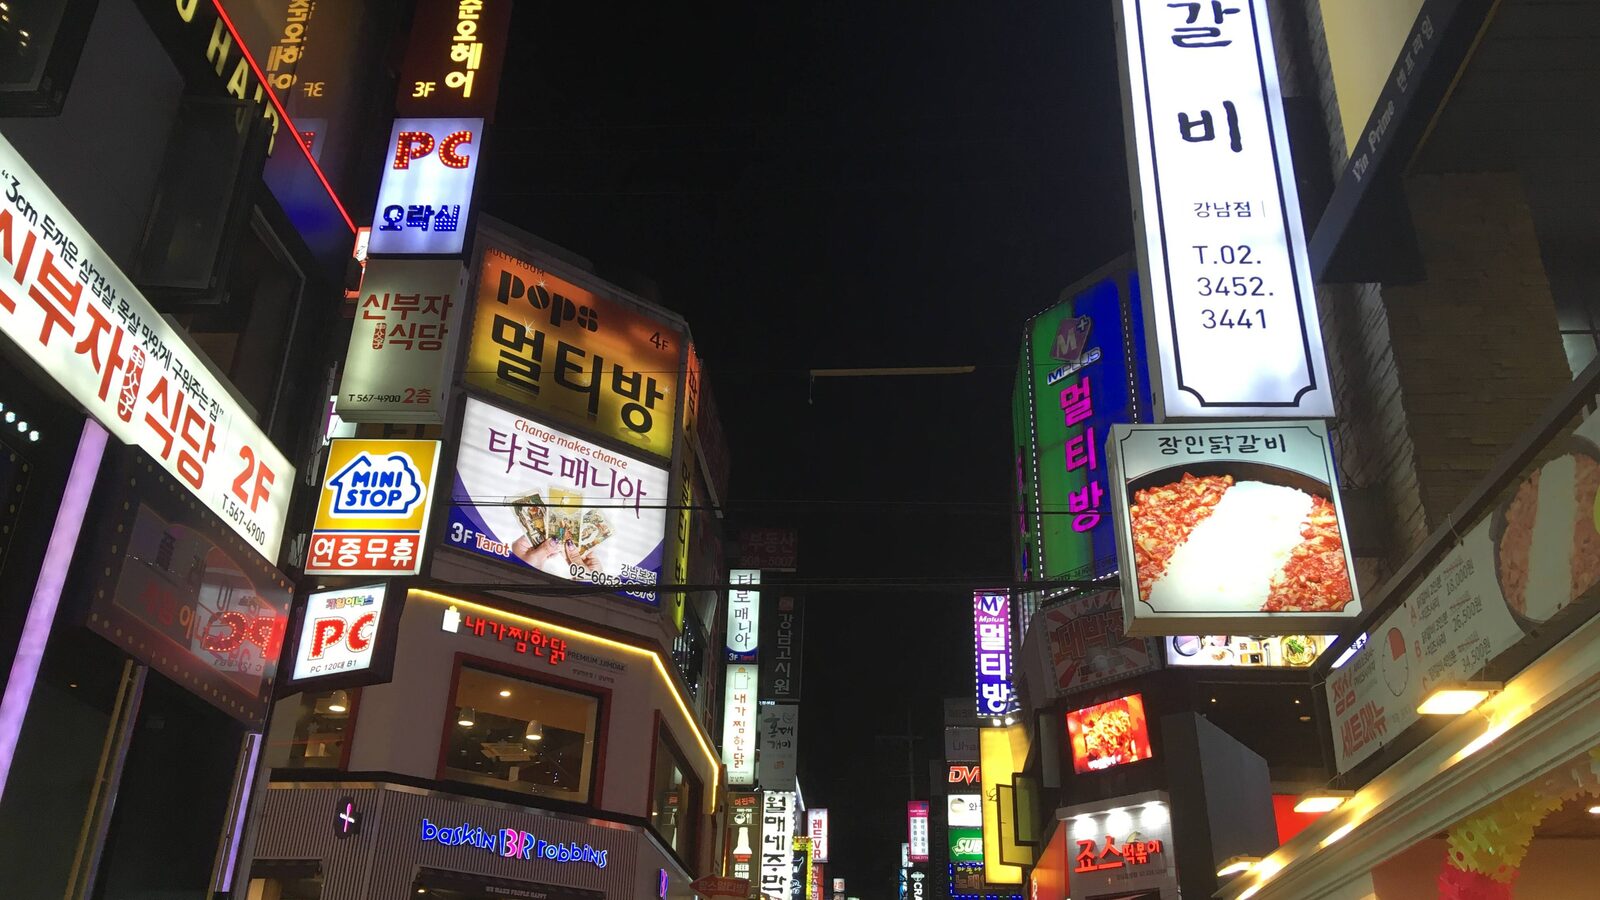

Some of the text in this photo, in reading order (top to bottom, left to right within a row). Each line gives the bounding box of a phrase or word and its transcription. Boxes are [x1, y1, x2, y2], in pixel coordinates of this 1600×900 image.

[412, 81, 436, 97] 3F
[1167, 0, 1242, 152] 갈비
[393, 130, 473, 169] PC
[379, 204, 461, 232] 오락실
[1193, 202, 1252, 218] 강남점
[515, 257, 545, 277] ROOM
[1197, 276, 1275, 297] 3452.
[40, 214, 78, 270] 두꺼운
[117, 298, 141, 337] 목살
[142, 326, 173, 372] 맛있게
[172, 358, 209, 412] 구워주는
[362, 293, 453, 321] 신부자
[1201, 308, 1267, 330] 3441
[388, 322, 449, 351] 식당
[649, 332, 670, 351] 4F
[491, 313, 665, 435] 멀티방
[348, 387, 432, 404] T 567-4900 2층
[144, 375, 217, 491] 식당
[231, 445, 276, 514] 2F
[514, 418, 628, 470] Change makes chance
[1059, 376, 1104, 533] 멀티방
[1158, 433, 1287, 456] 장인닭갈비
[352, 471, 403, 488] MINI
[488, 427, 647, 519] 타로 매니아
[345, 490, 402, 508] STOP
[222, 493, 266, 547] T.567-4900
[314, 537, 414, 568] 연중무휴
[451, 522, 512, 558] 3F Tarot
[307, 611, 378, 661] PC
[465, 614, 567, 666] 내가찜한닭
[774, 613, 795, 696] 강남고시원
[310, 665, 321, 673] PC
[346, 659, 357, 668] B1
[979, 623, 1010, 713] 멀티방
[732, 693, 747, 769] 내가찜한닭
[421, 818, 608, 869] baskin BR robbins
[812, 819, 823, 859] 레드VR
[1074, 834, 1163, 873] 죠스떡볶이
